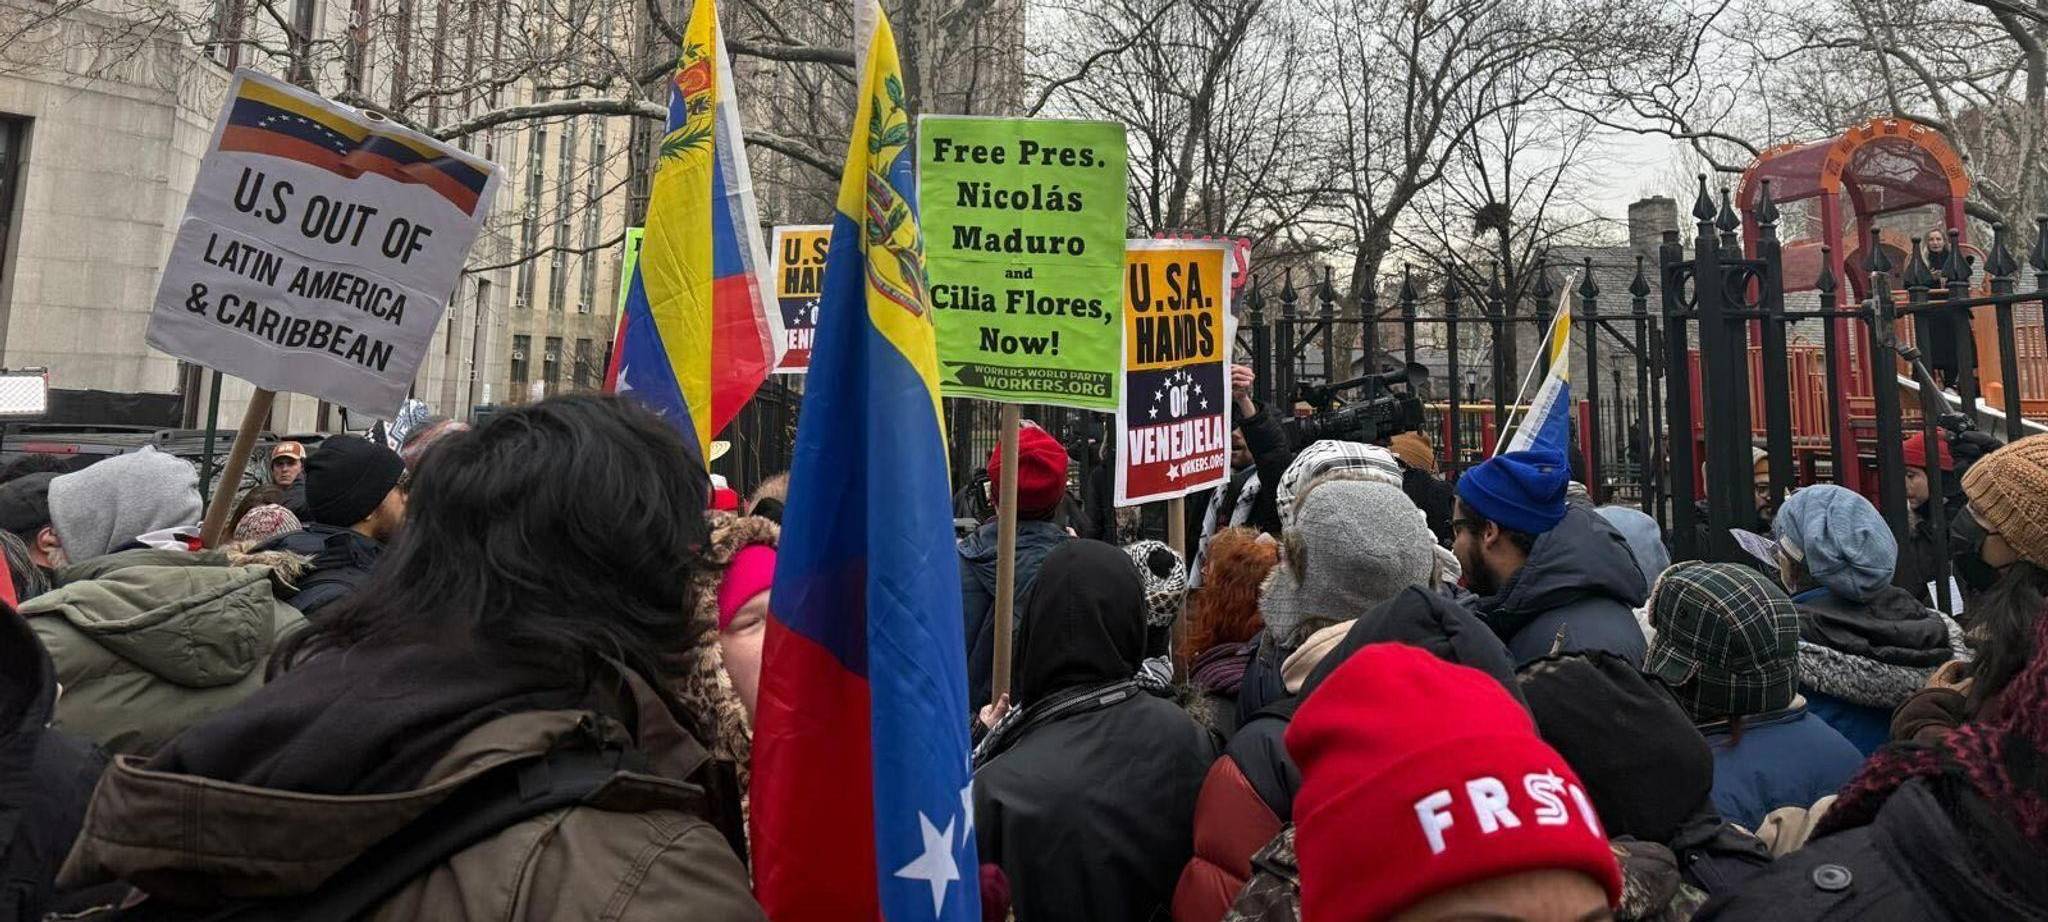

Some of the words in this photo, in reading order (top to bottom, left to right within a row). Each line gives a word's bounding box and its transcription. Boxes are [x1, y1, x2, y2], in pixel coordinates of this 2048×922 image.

[933, 138, 1005, 165] Free
[1018, 140, 1105, 168] Pres.
[956, 181, 1083, 212] Nicolás
[234, 167, 294, 224] U.S
[301, 195, 378, 247] OUT
[381, 218, 432, 264] OF
[952, 225, 1085, 256] Maduro
[203, 233, 284, 286] LATIN
[287, 267, 407, 326] AMERICA
[1005, 267, 1033, 280] and
[930, 284, 997, 313] Cilia
[1005, 290, 1112, 325] Flores,
[185, 283, 209, 316] &
[216, 294, 394, 371] CARIBBEAN
[979, 326, 1059, 356] Now!
[1136, 312, 1214, 364] HANDS
[975, 365, 1024, 377] WORKERS
[1025, 369, 1067, 380] WORLD
[1069, 371, 1106, 383] PARTY
[983, 376, 1106, 396] WORKERS.ORG
[1128, 415, 1224, 466] VENEZUELA
[1180, 453, 1224, 477] WRKERS.ORG
